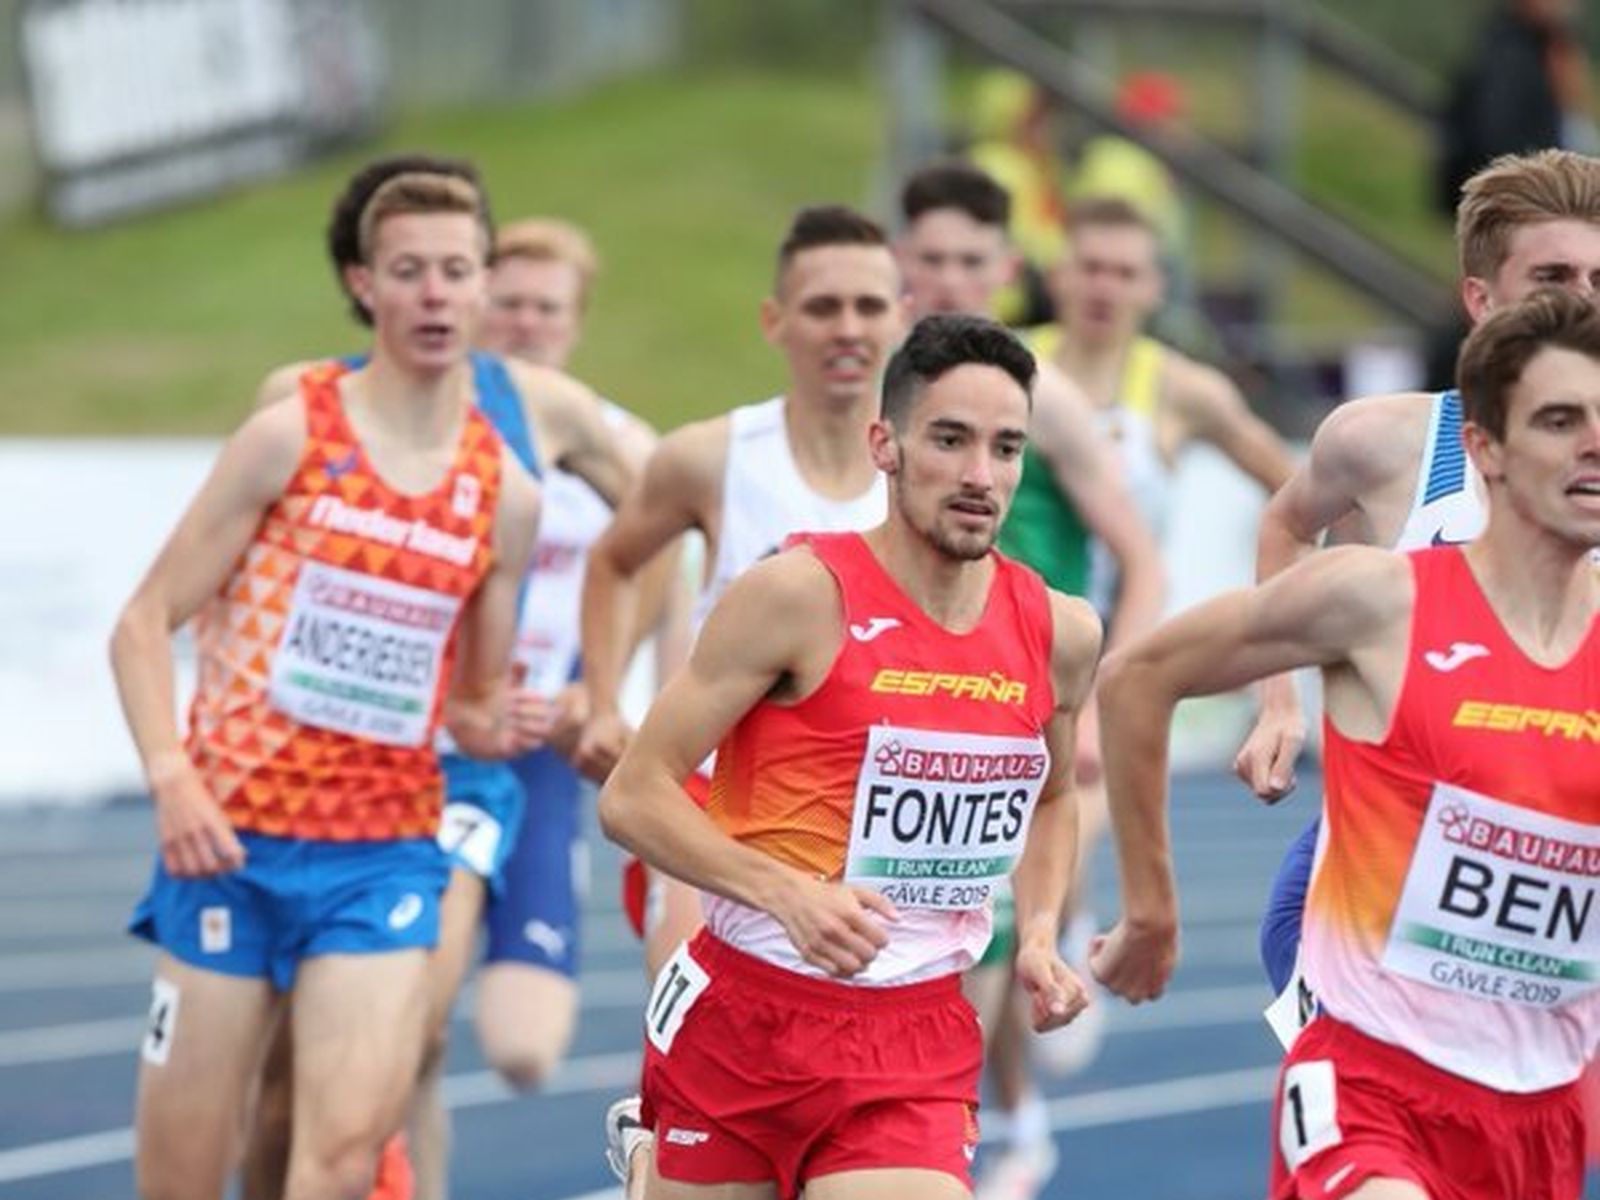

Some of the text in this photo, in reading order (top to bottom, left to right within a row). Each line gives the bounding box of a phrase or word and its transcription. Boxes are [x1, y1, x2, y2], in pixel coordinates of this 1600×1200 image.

[870, 669, 1028, 705] ESPAÑA
[903, 750, 1046, 783] BAUHAUS
[862, 784, 1028, 845] FONTES
[886, 860, 990, 875] I RUN CLEAN
[880, 883, 990, 905] GÄVLE 2019
[1438, 855, 1595, 943] BEN
[1440, 935, 1563, 976] I RUN CLEAN
[651, 962, 690, 1035] 11
[1509, 979, 1561, 1005] 2019
[1288, 1083, 1308, 1147] 1
